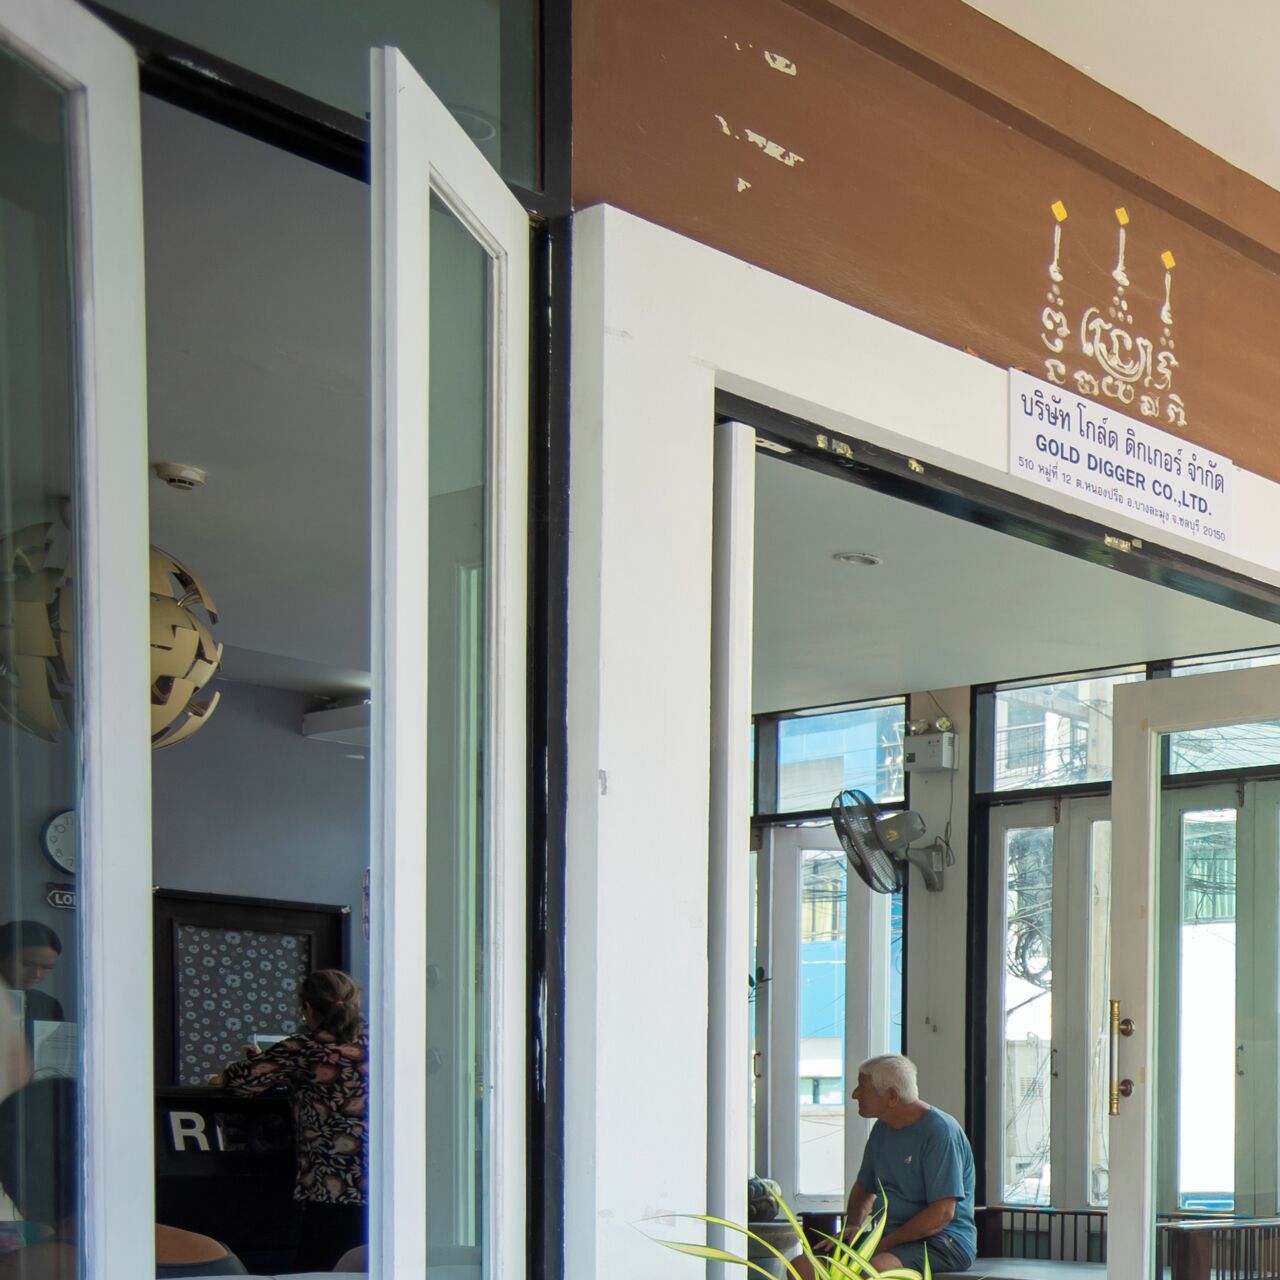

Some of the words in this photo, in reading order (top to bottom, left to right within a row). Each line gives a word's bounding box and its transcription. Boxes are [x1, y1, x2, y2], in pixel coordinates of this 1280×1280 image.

[1021, 389, 1071, 432] บริษัท
[1076, 402, 1119, 451] โกล์ด
[1125, 427, 1183, 476] ดิกเกอร์
[1187, 453, 1224, 493] จำกัด
[1036, 434, 1080, 464] GOLD
[1087, 453, 1146, 491] DIGGER
[1152, 479, 1212, 516] CO.,LTD.
[1018, 456, 1034, 470] 510
[1062, 473, 1072, 484] 12
[1203, 526, 1226, 541] 20150
[55, 893, 76, 905] LO
